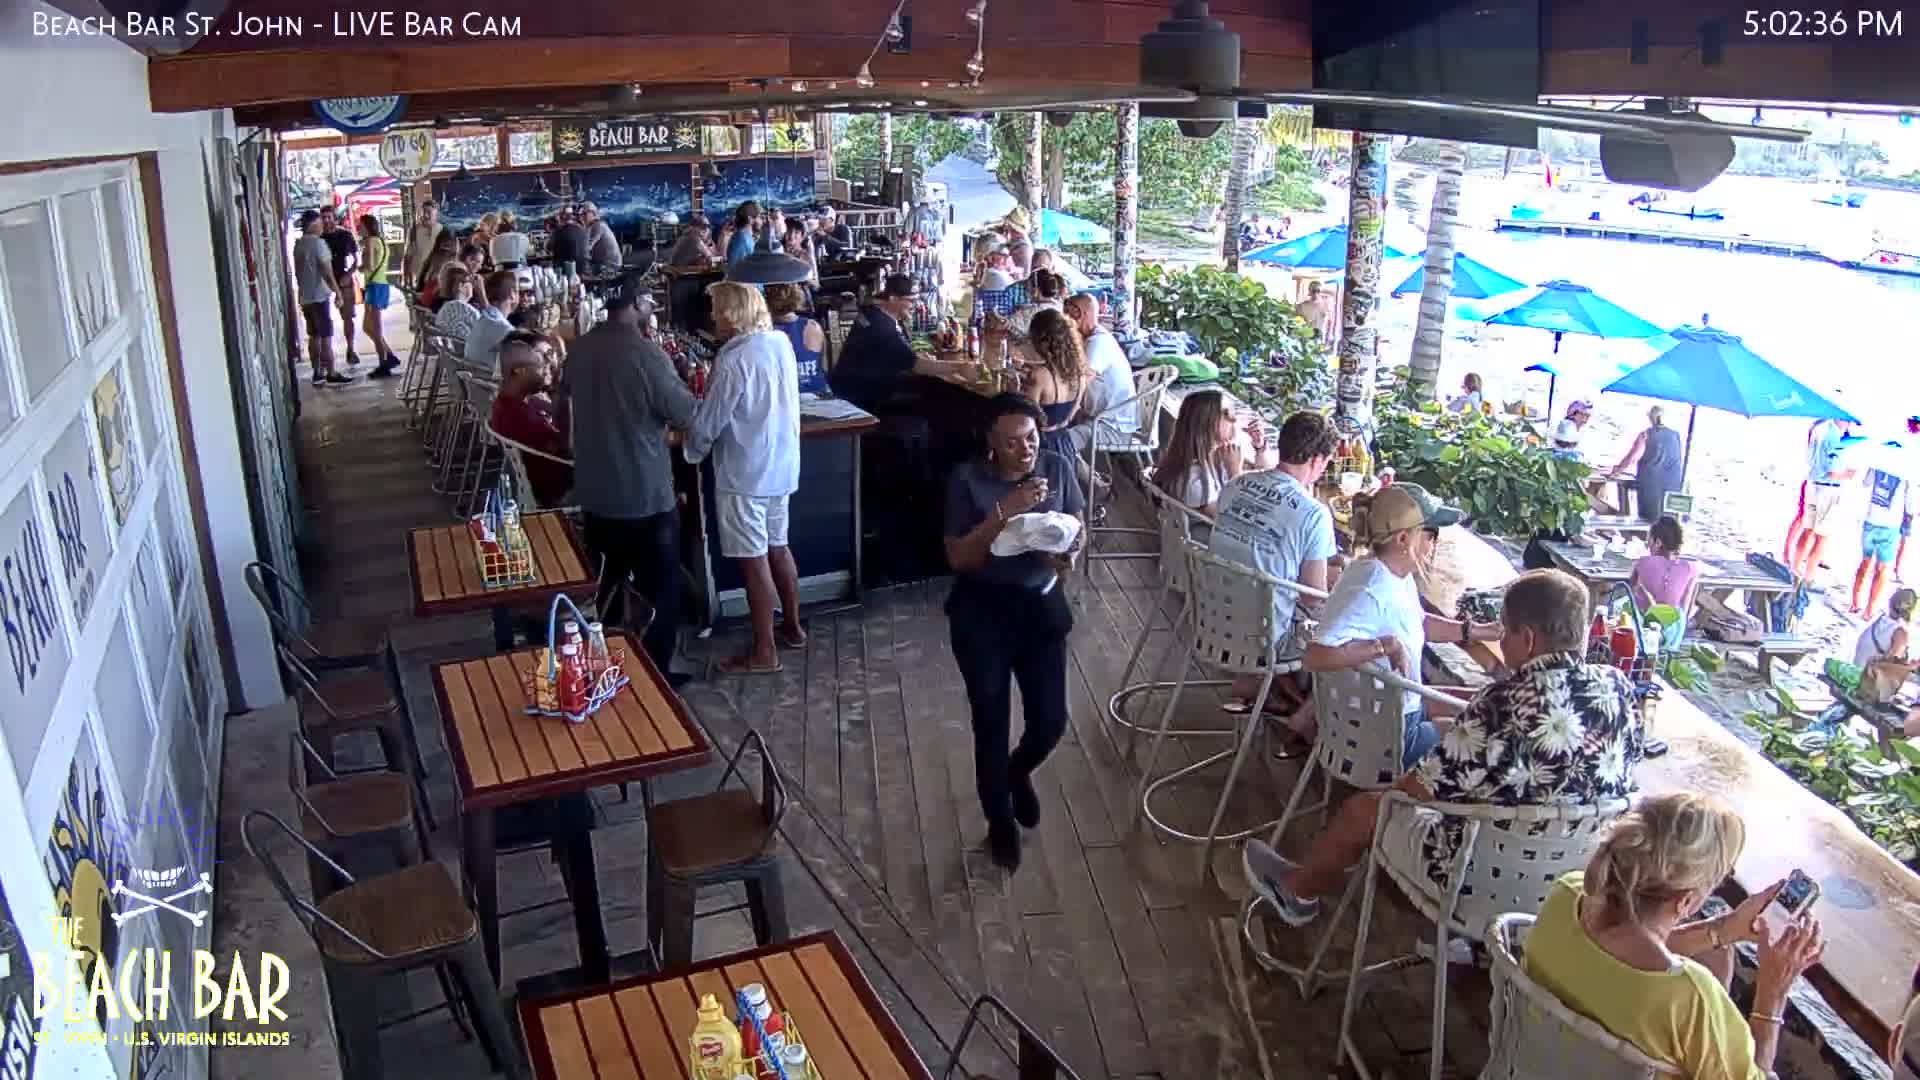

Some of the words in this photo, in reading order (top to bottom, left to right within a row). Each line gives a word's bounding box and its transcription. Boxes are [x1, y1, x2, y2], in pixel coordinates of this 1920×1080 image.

[388, 134, 405, 156] TO
[410, 132, 426, 151] GO
[589, 127, 633, 147] BEACH
[638, 125, 669, 145] BAR
[0, 515, 58, 697] BEACH
[48, 471, 88, 585] BAR
